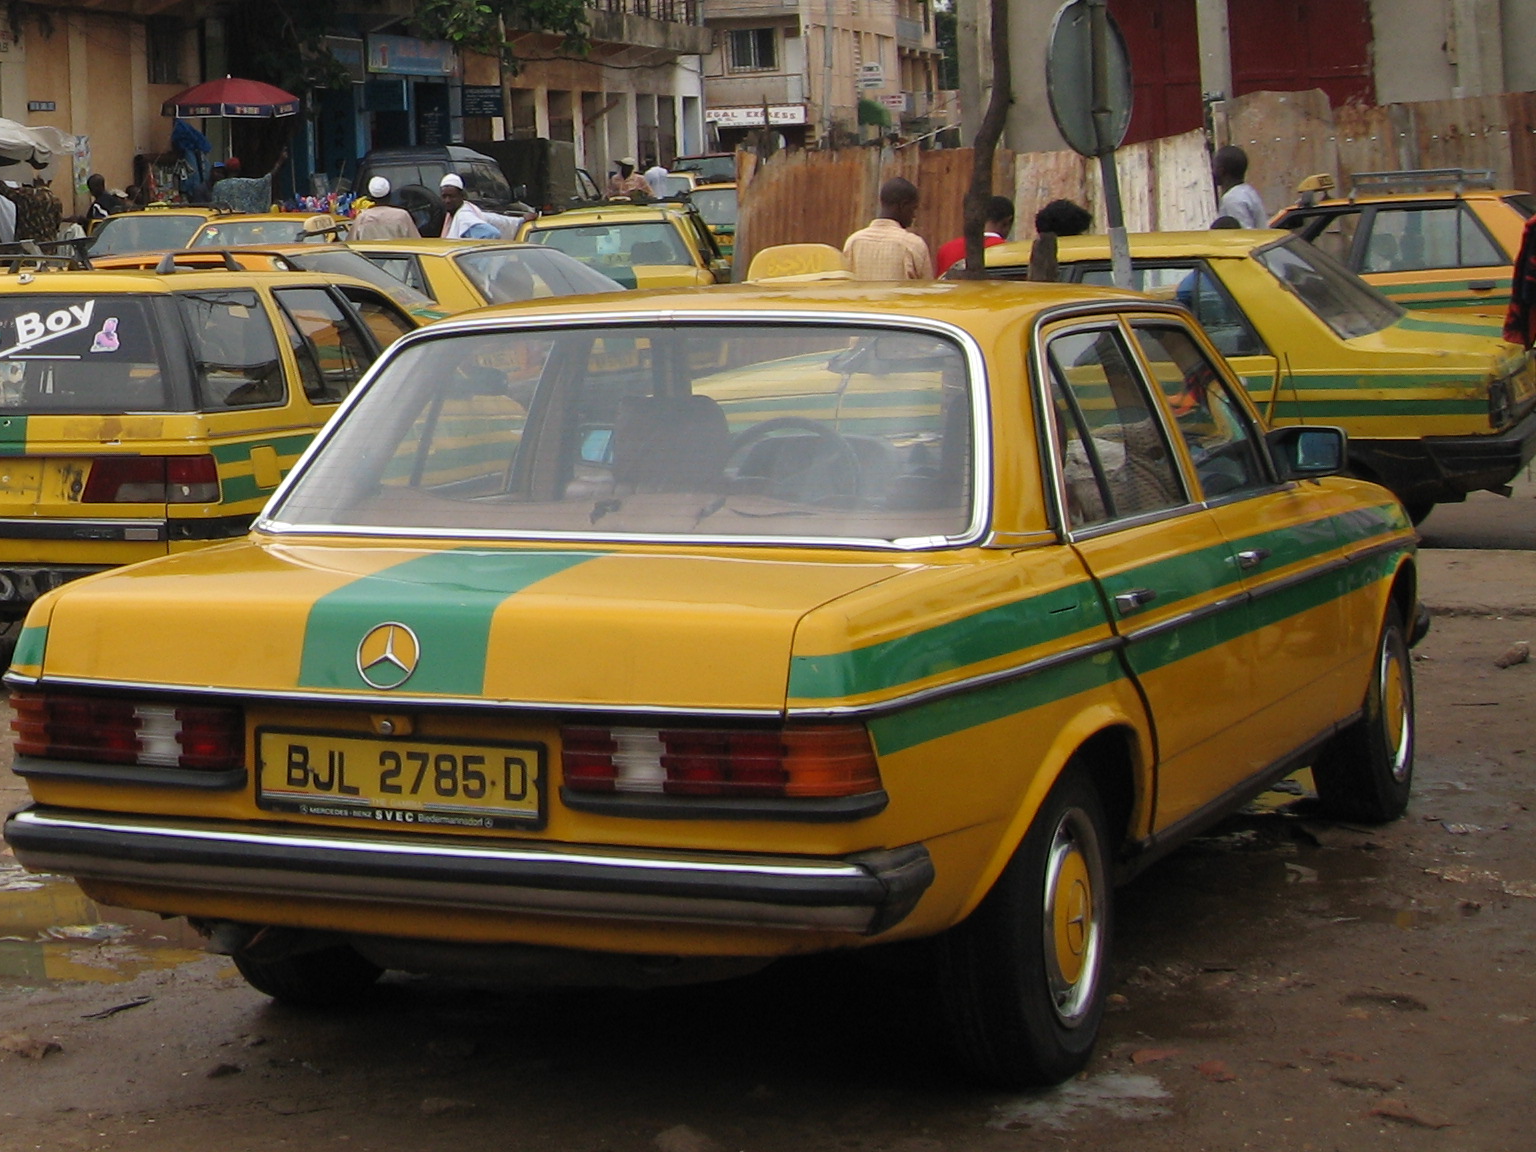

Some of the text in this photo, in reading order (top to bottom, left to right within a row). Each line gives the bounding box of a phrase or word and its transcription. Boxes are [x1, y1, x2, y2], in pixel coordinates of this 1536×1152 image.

[15, 299, 96, 345] Boy
[286, 744, 528, 802] BJL 2785 D
[375, 809, 414, 823] SVEC
[417, 813, 484, 827] Biedermannsdorf
